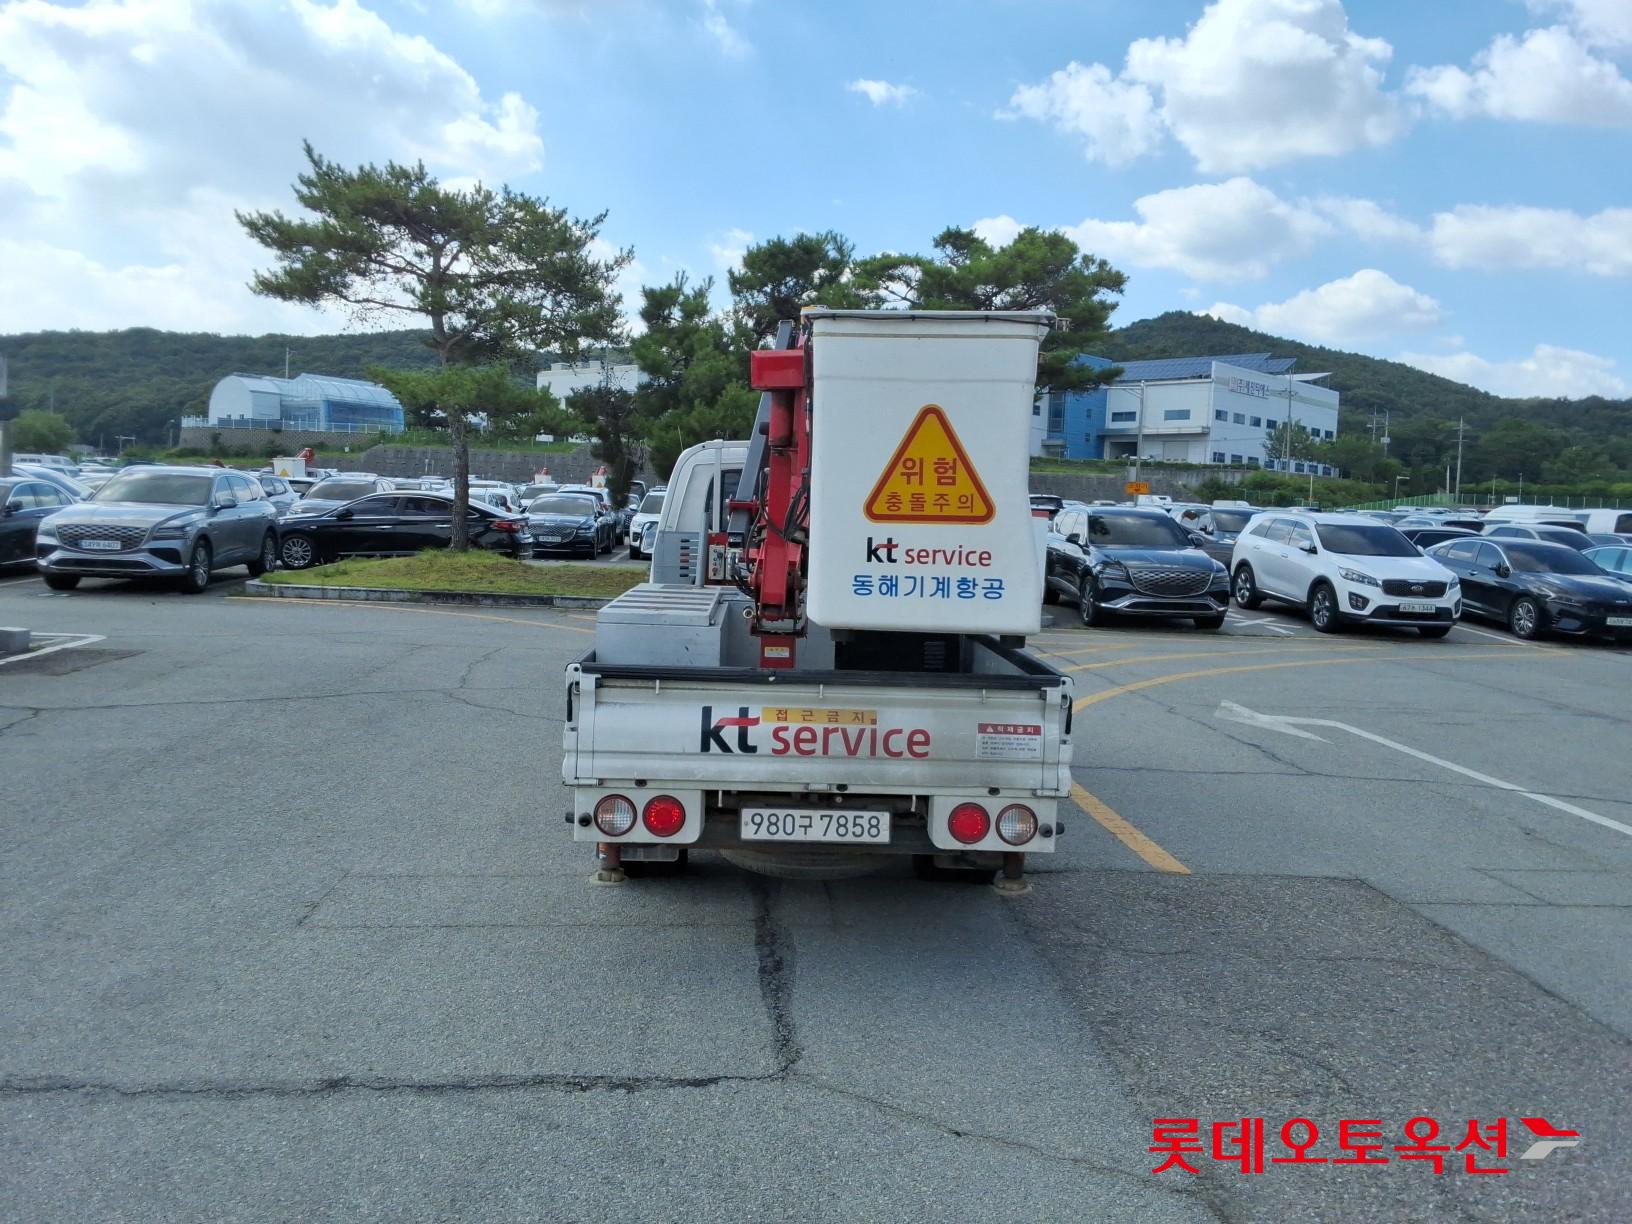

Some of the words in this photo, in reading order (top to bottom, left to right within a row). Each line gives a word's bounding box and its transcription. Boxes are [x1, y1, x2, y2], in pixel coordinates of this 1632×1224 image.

[900, 457, 957, 486] 위험
[885, 492, 974, 513] 충돌주의
[866, 537, 899, 563] kt
[904, 545, 992, 567] service
[852, 574, 1005, 600] 동해기계항공
[776, 709, 865, 723] 접근금지
[700, 706, 760, 754] kt
[771, 718, 931, 758] service
